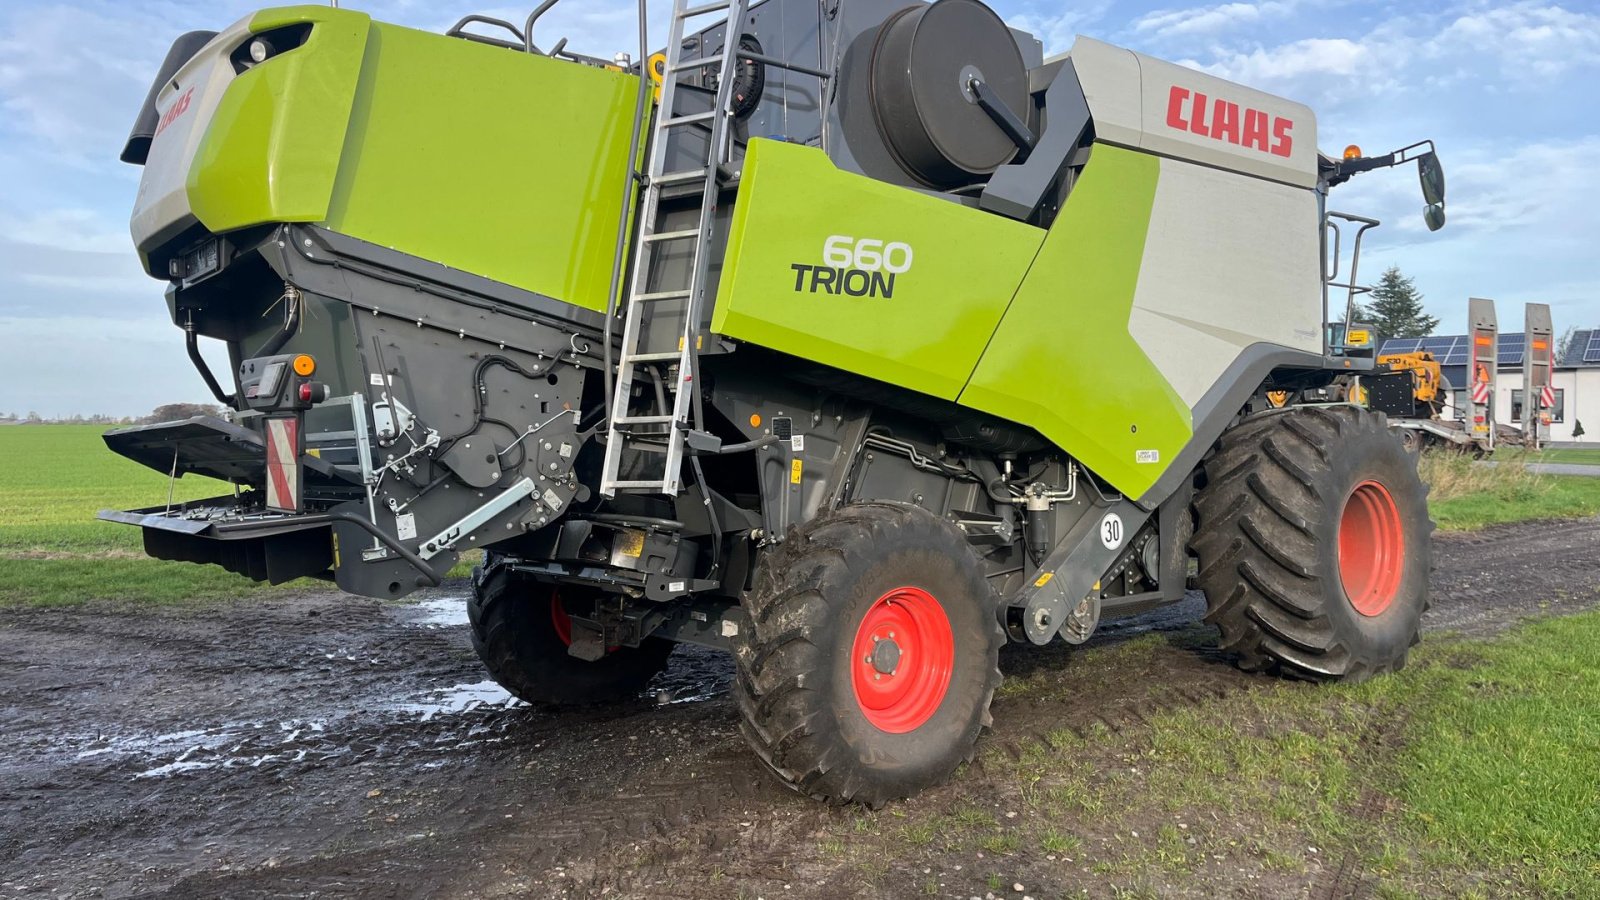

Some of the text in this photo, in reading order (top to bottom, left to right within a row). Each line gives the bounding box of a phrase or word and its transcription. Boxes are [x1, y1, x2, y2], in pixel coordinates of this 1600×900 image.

[1166, 85, 1293, 158] CLAAS
[823, 235, 913, 273] 660
[791, 263, 896, 299] TRION
[1105, 520, 1120, 543] 30
